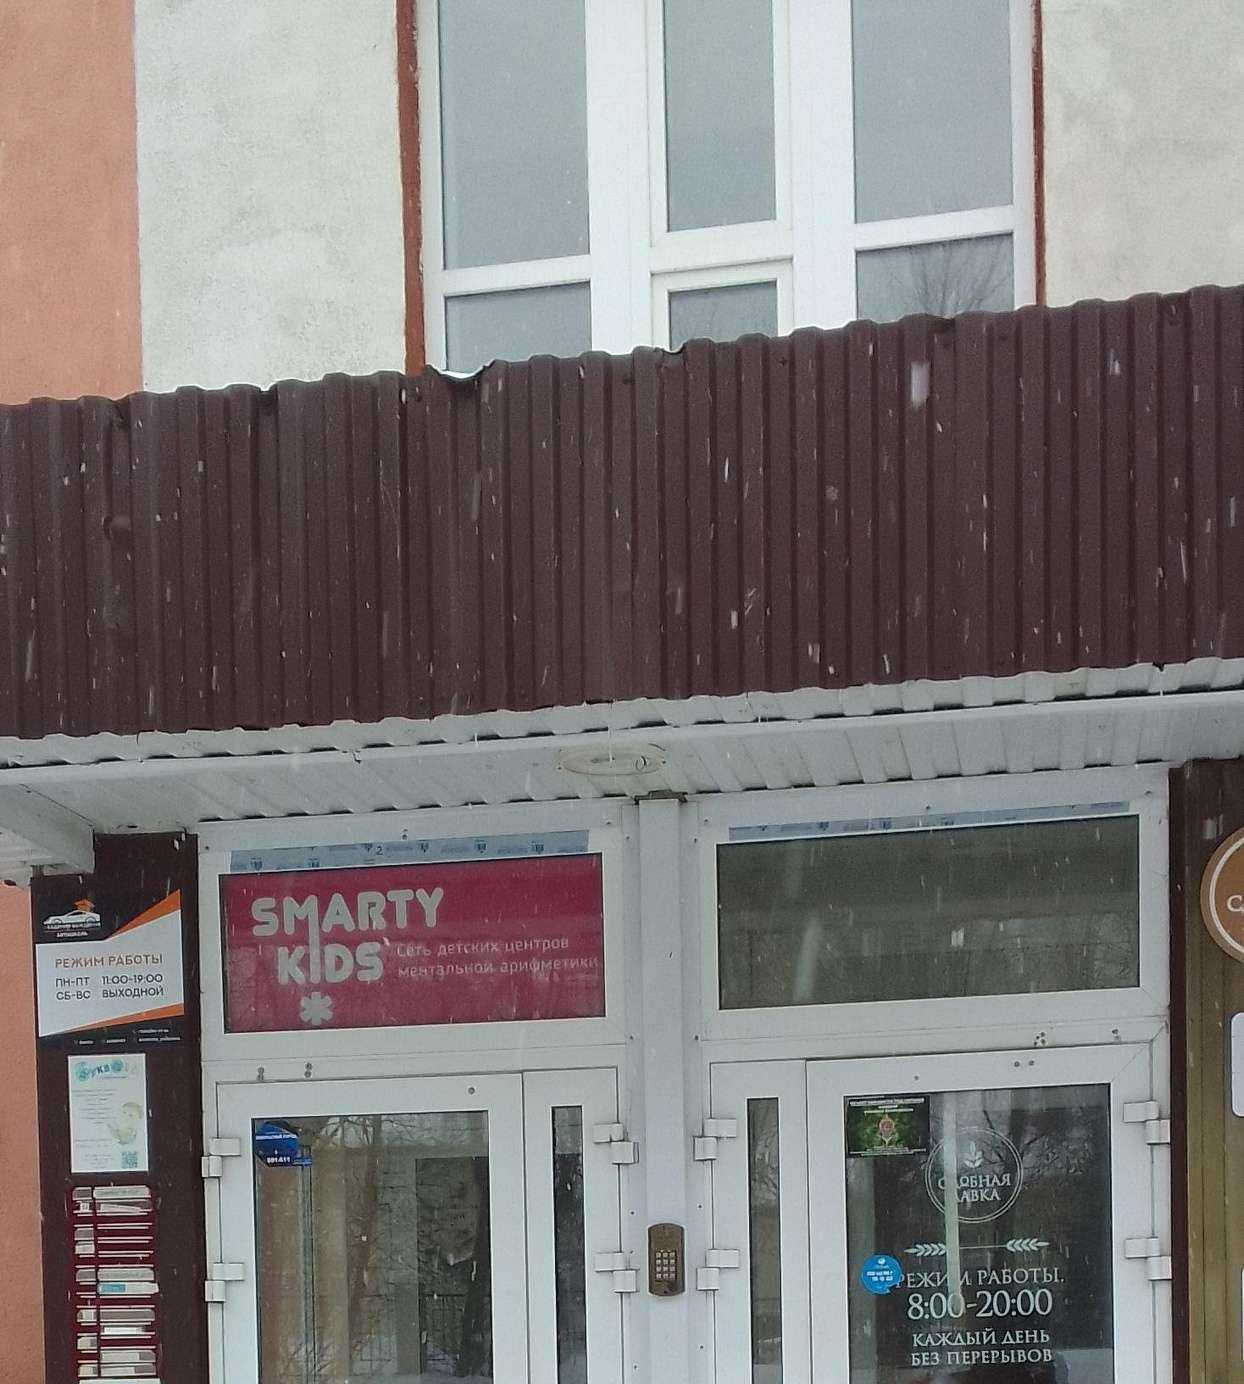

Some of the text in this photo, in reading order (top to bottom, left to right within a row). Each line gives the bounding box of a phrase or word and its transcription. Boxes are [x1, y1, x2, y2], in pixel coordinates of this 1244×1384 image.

[251, 887, 444, 936] SMARTY
[396, 937, 569, 957] Сеть детских центров
[55, 953, 163, 969] РЕЖИМ РАБОТЫ
[278, 942, 384, 986] KIDS
[398, 957, 600, 978] ментальной арифметики
[55, 973, 163, 988] ПН-ПТ 11:00-19:00
[56, 985, 164, 1000] СБ-ВС ВЫХОДНОЙ
[907, 1289, 1053, 1320] 8:00-20:00
[912, 1328, 1050, 1347] КАЖДЫЙ ДЕНЬ
[911, 1348, 1053, 1366] БЕЗ ПЕРЕРЫВОВ
